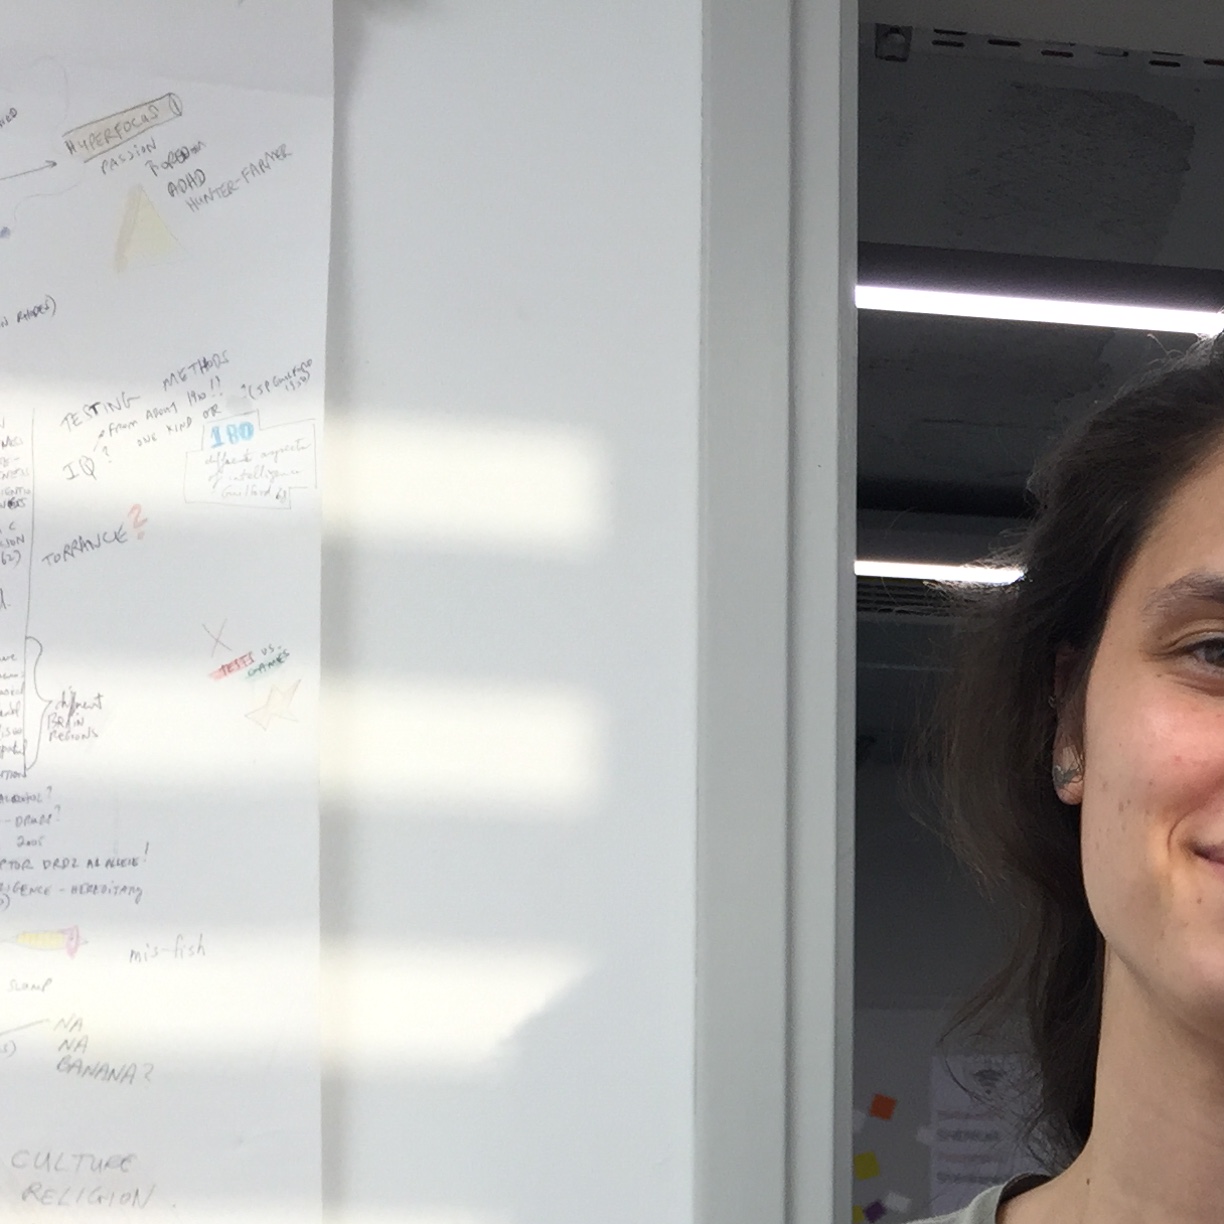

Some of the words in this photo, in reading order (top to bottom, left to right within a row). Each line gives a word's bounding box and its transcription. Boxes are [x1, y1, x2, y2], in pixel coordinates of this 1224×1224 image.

[167, 168, 206, 198] ADHD
[60, 391, 141, 432] TESTING
[162, 350, 230, 391] METHODS
[210, 421, 255, 449] 180
[58, 1035, 89, 1054] NA
[11, 1149, 138, 1173] CULTURE
